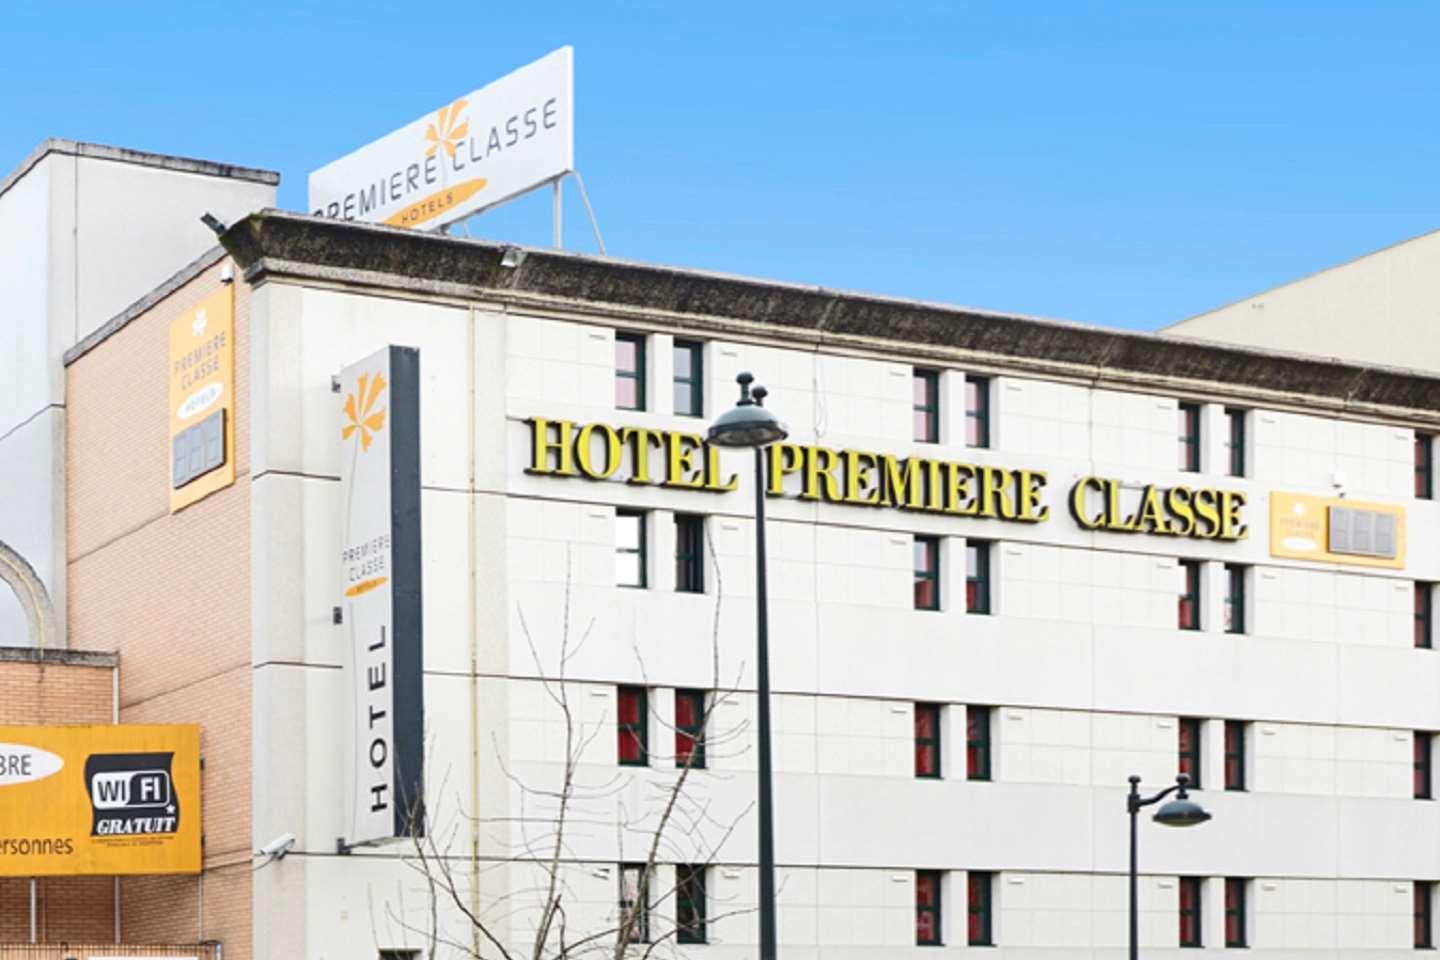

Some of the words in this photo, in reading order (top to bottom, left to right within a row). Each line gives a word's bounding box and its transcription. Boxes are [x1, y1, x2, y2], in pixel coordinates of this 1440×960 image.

[452, 97, 557, 172] CLASSE
[401, 191, 454, 224] HOTELS
[525, 416, 738, 493] HOTEL
[765, 442, 1049, 523] PREMIERE
[1069, 474, 1249, 541] CLASSE
[368, 625, 388, 813] HOTEL
[97, 816, 176, 836] GRATUIT
